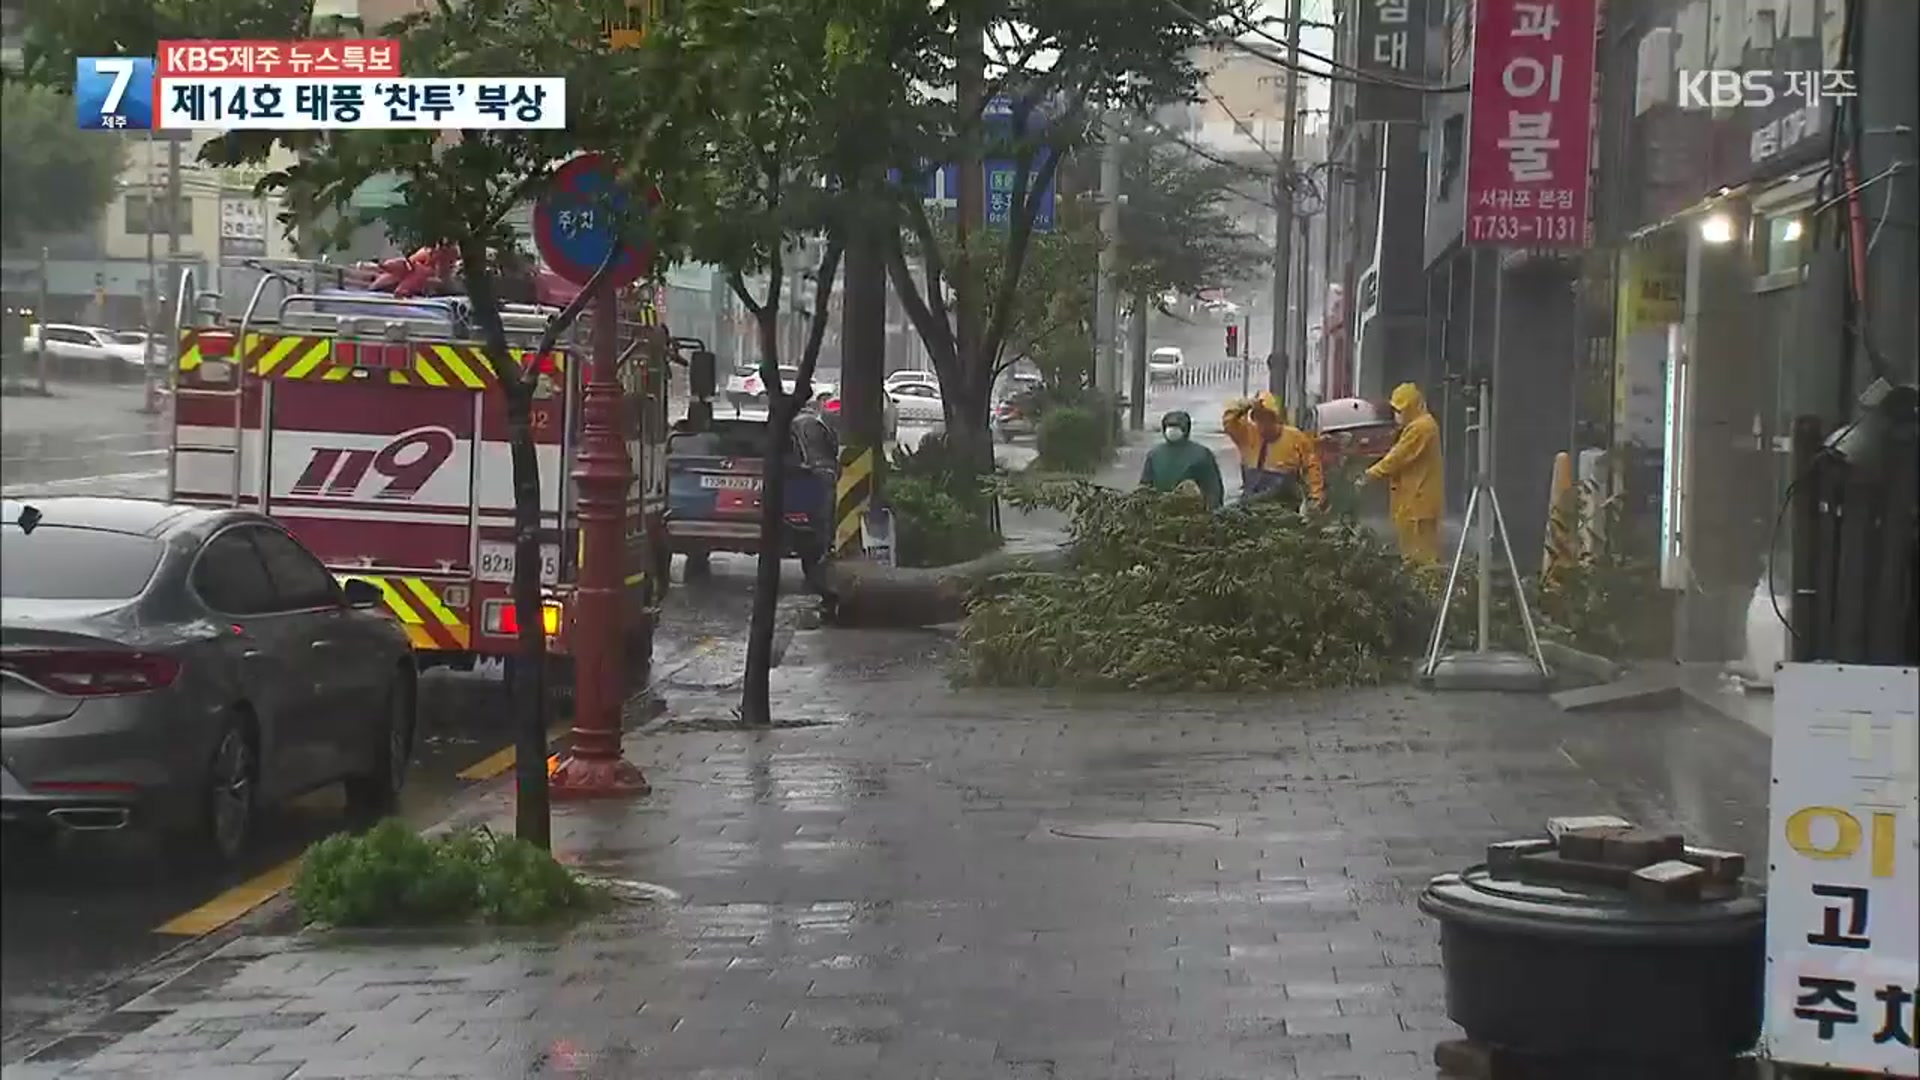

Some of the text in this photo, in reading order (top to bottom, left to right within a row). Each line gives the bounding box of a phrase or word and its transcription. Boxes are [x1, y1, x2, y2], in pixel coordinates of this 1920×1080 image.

[1480, 189, 1574, 209] 서귀포 본점
[1471, 215, 1576, 241] T.733-1131
[289, 425, 457, 500] 119
